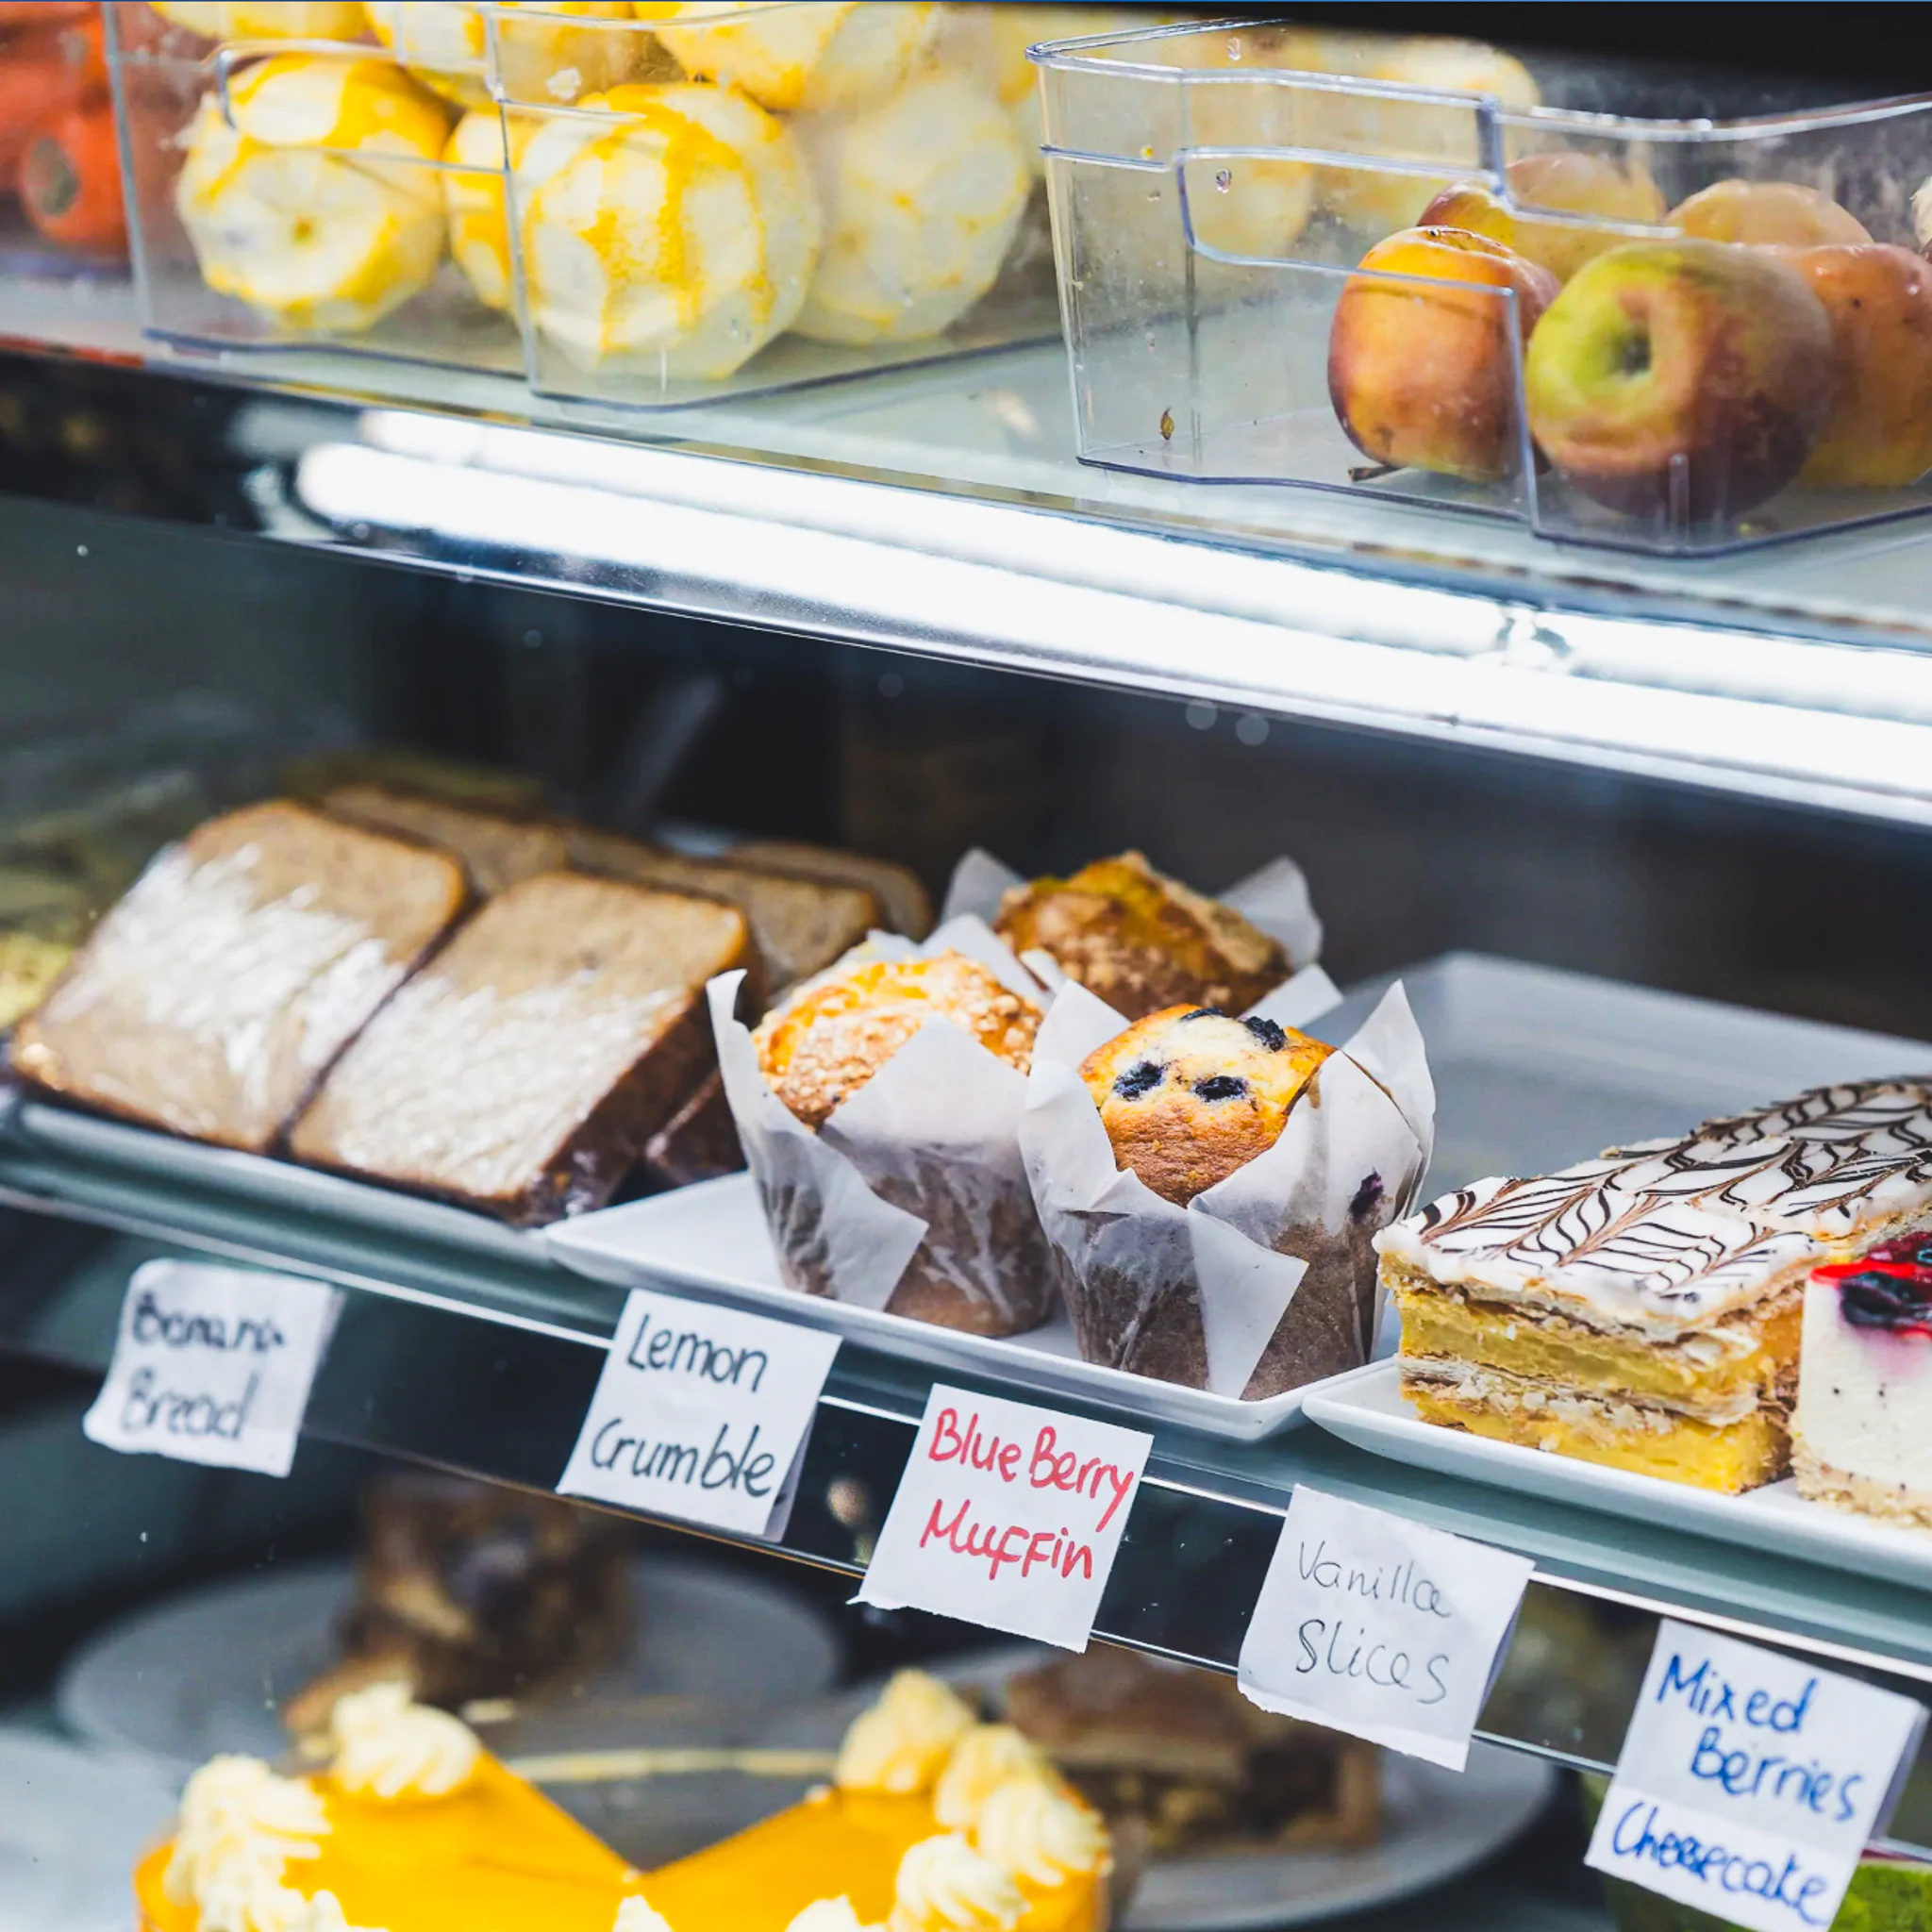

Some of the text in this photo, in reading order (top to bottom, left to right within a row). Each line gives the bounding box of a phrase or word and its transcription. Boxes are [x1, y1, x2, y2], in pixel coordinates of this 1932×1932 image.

[626, 1313, 768, 1392] Lemon
[122, 1365, 261, 1441] Bread
[590, 1417, 775, 1497] Crumble
[1299, 1540, 1452, 1618] Vanilla
[1295, 1618, 1450, 1705] Slices
[1656, 1653, 1820, 1734] Mixed
[1690, 1727, 1865, 1822] Berries
[1611, 1799, 1832, 1927] Cheesecake
